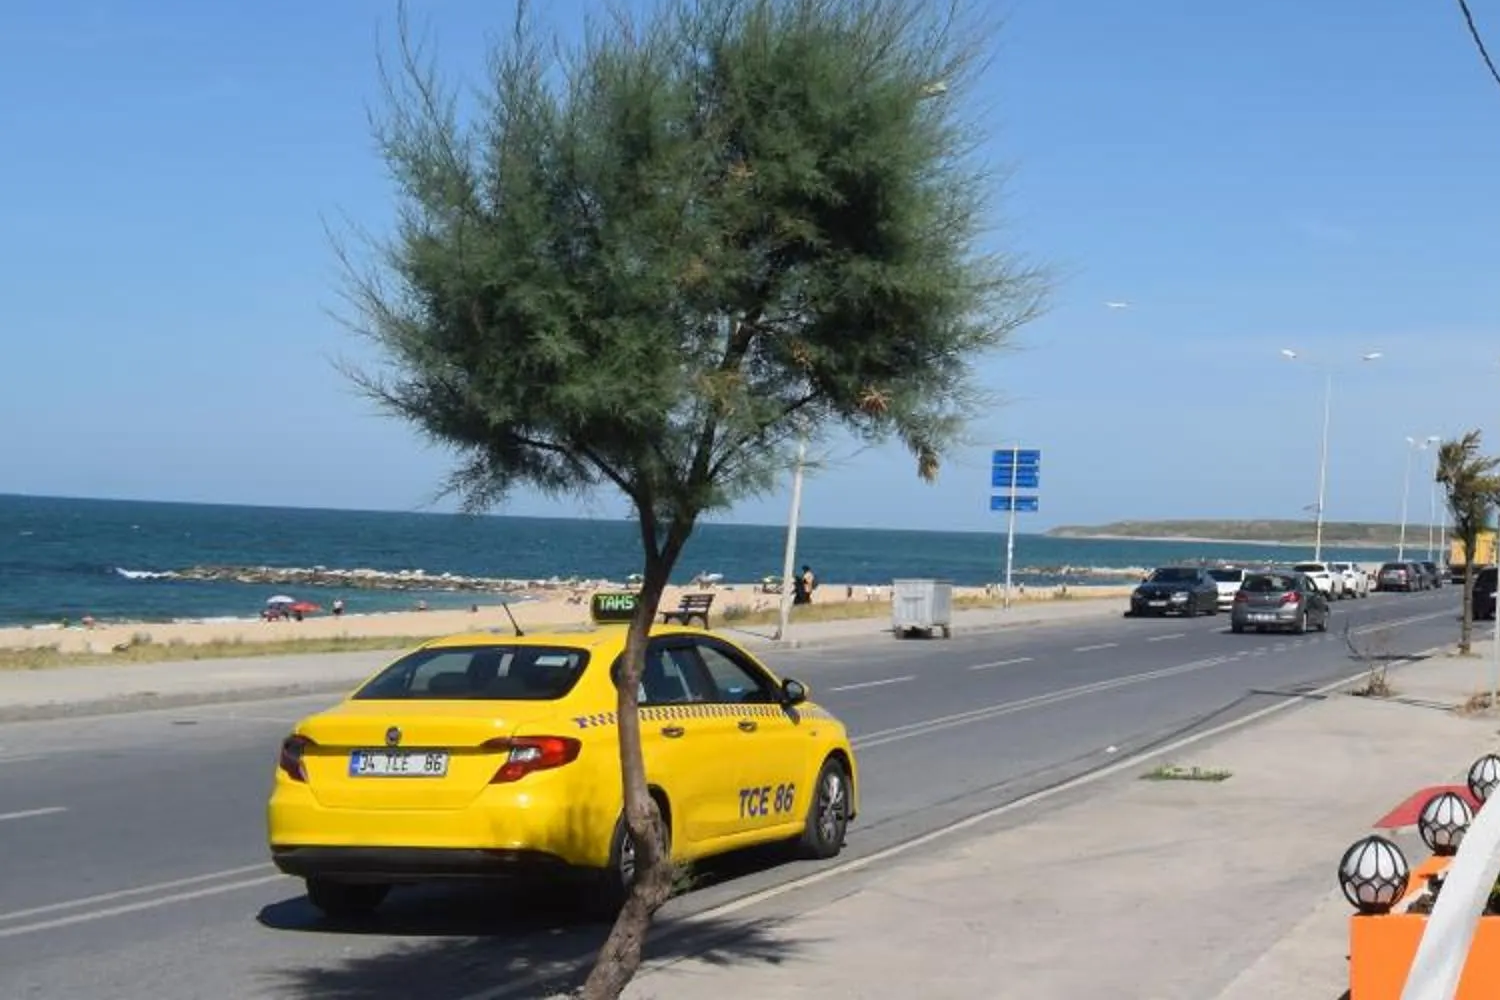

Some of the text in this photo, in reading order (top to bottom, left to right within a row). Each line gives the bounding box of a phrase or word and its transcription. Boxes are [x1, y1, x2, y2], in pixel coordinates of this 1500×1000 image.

[360, 752, 375, 771] 34
[739, 782, 795, 820] TCE 86
